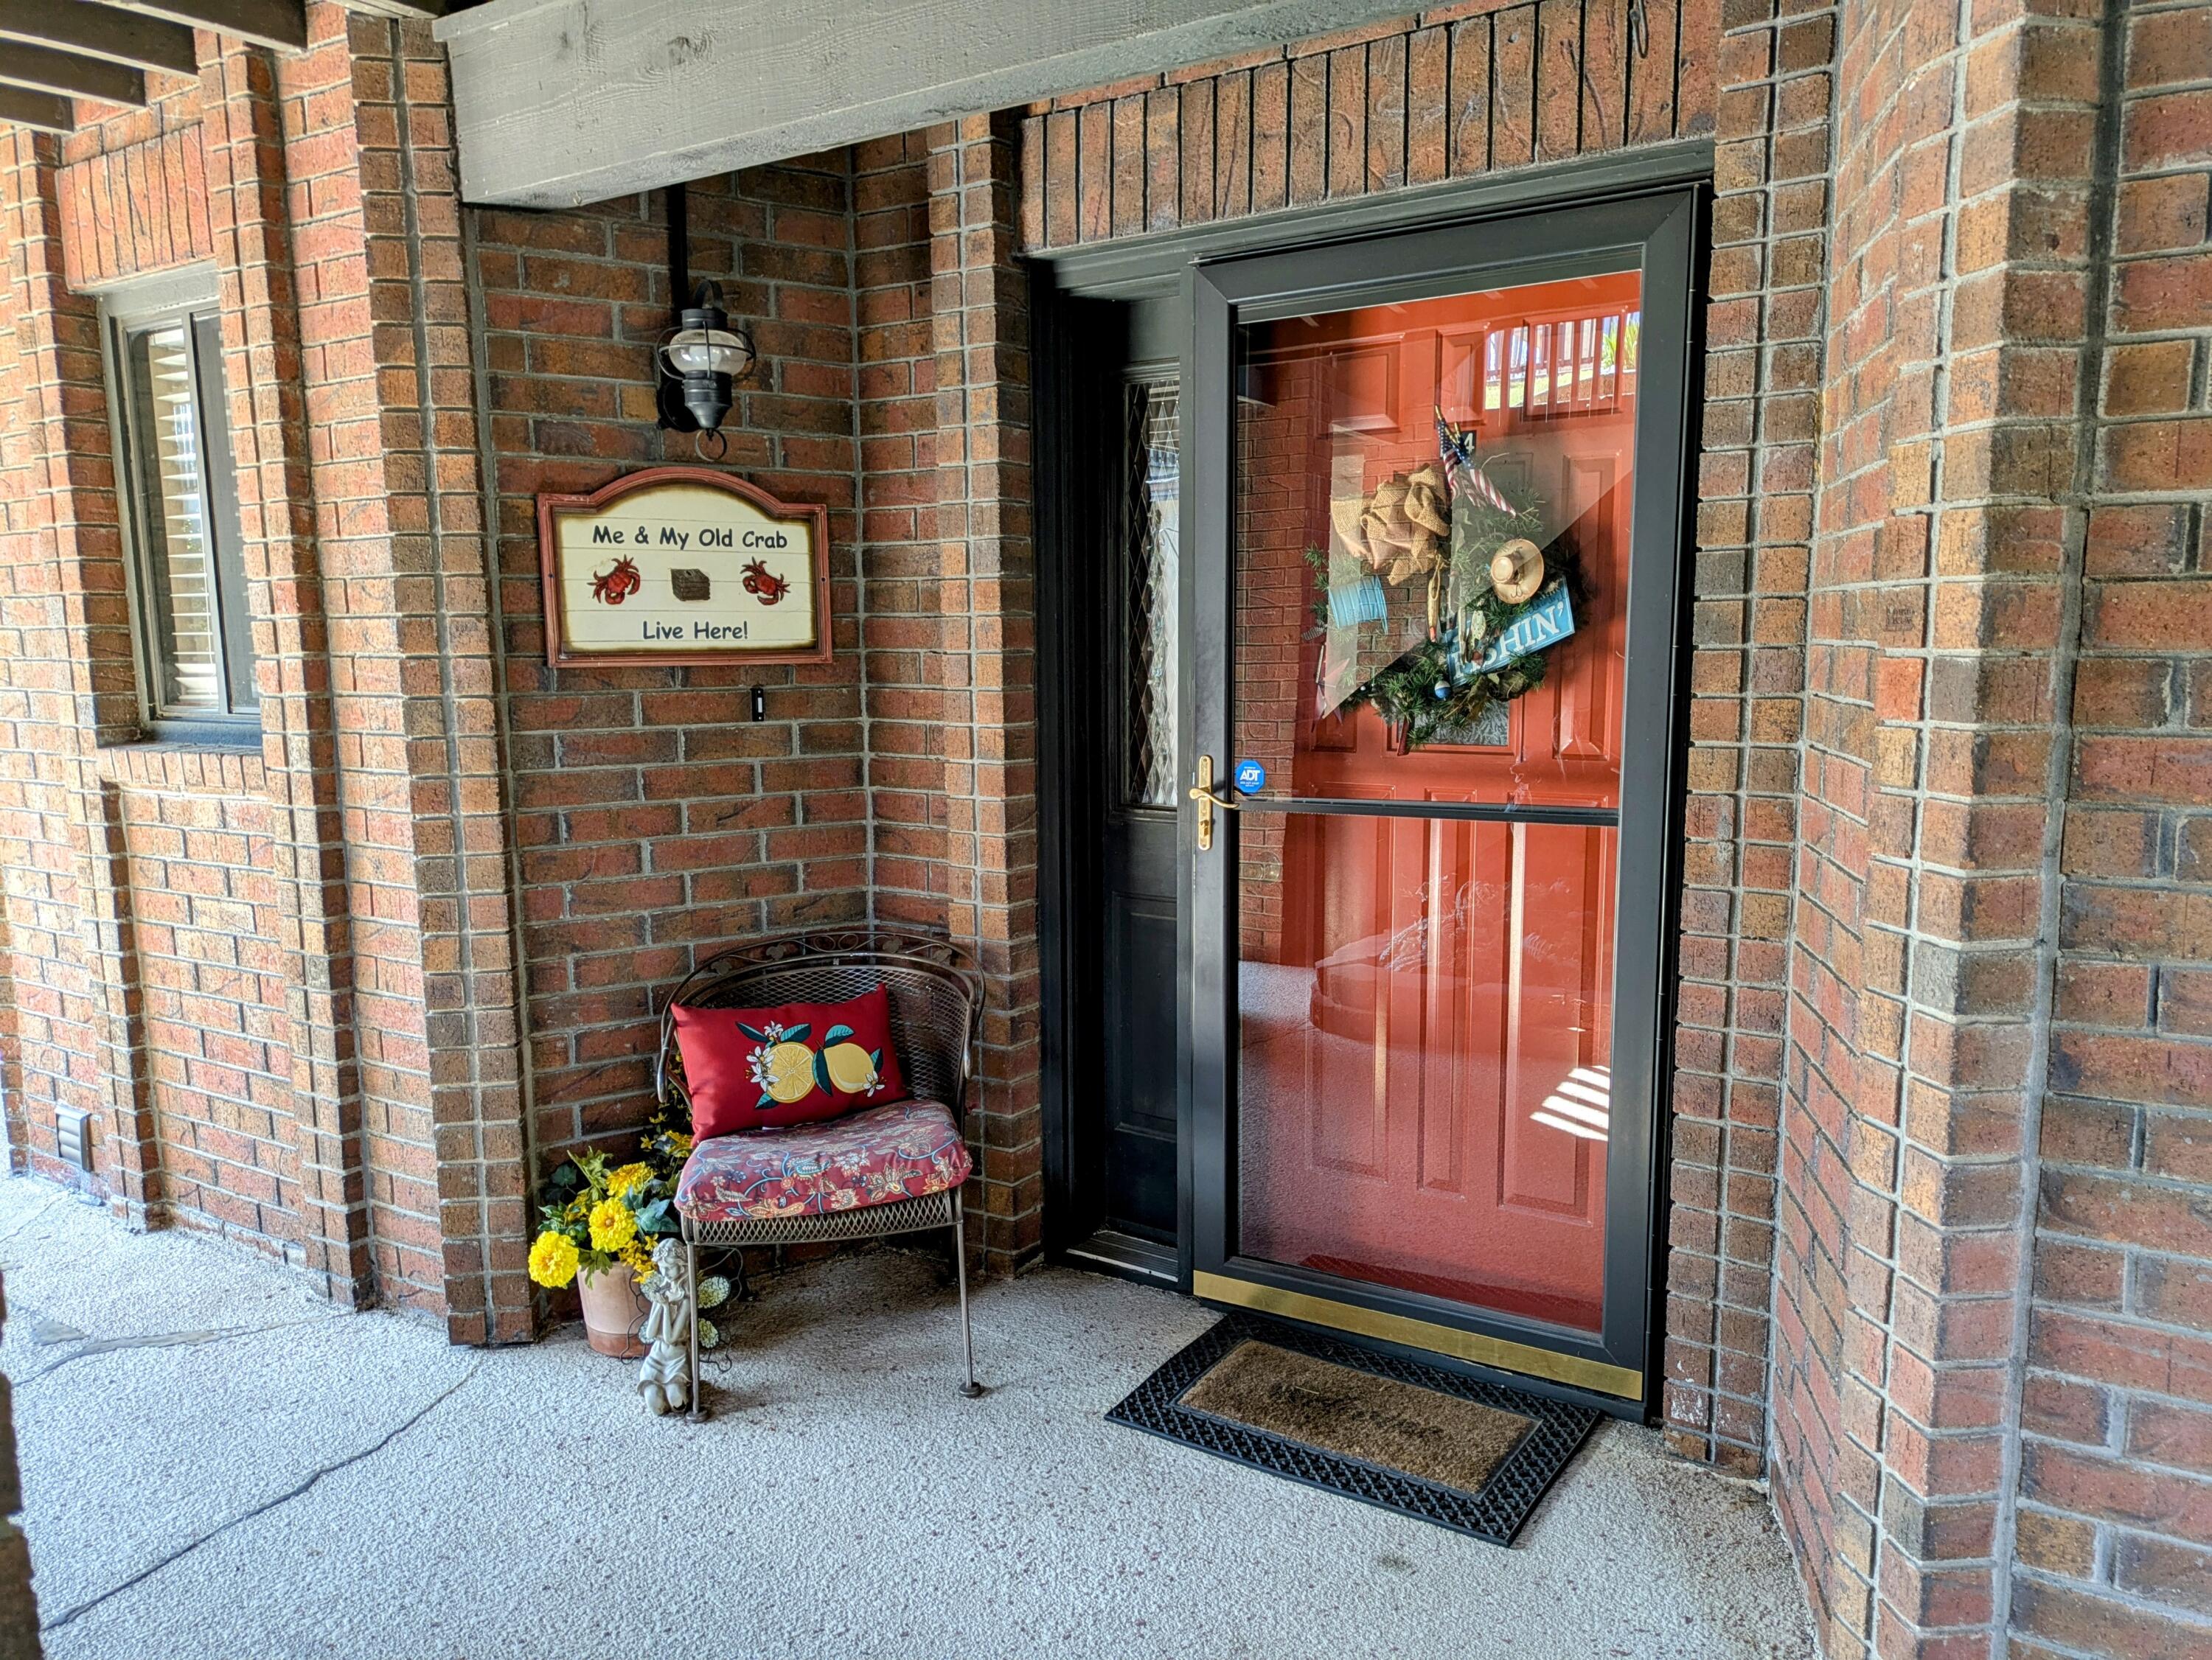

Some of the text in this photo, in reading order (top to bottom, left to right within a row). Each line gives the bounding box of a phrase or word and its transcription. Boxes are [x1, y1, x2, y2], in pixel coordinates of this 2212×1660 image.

[592, 525, 788, 550] Me & My Old Crab
[642, 621, 748, 640] Live Here!
[1239, 770, 1261, 781] ADT
